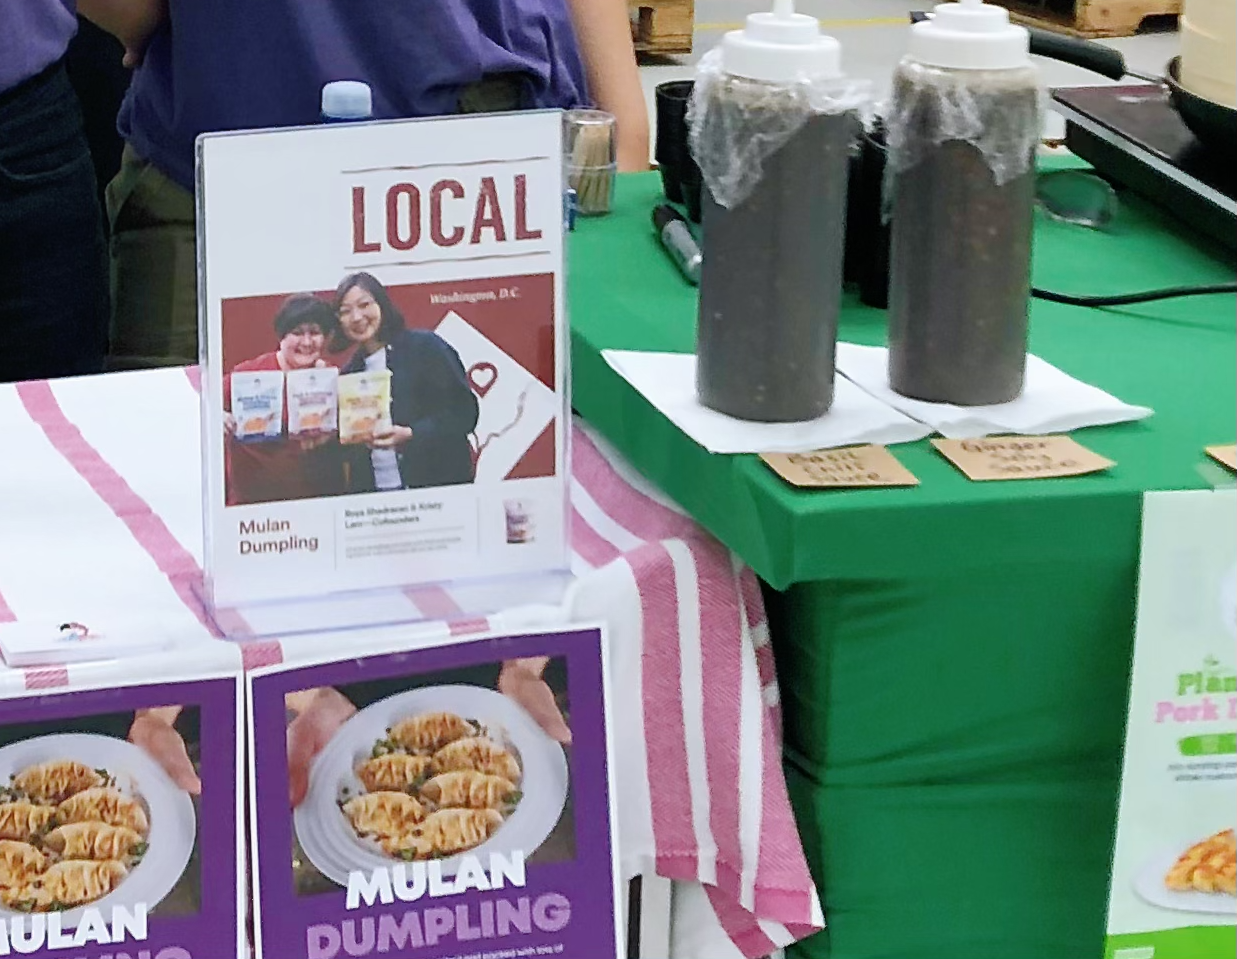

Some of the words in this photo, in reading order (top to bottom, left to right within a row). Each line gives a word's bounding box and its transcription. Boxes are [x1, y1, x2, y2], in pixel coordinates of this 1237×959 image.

[351, 173, 543, 254] LOCAL
[239, 517, 291, 535] Mulan
[240, 535, 319, 555] Dumpling
[1155, 697, 1219, 723] Pork
[346, 849, 527, 910] MULAN
[306, 892, 572, 959] DUMPLING
